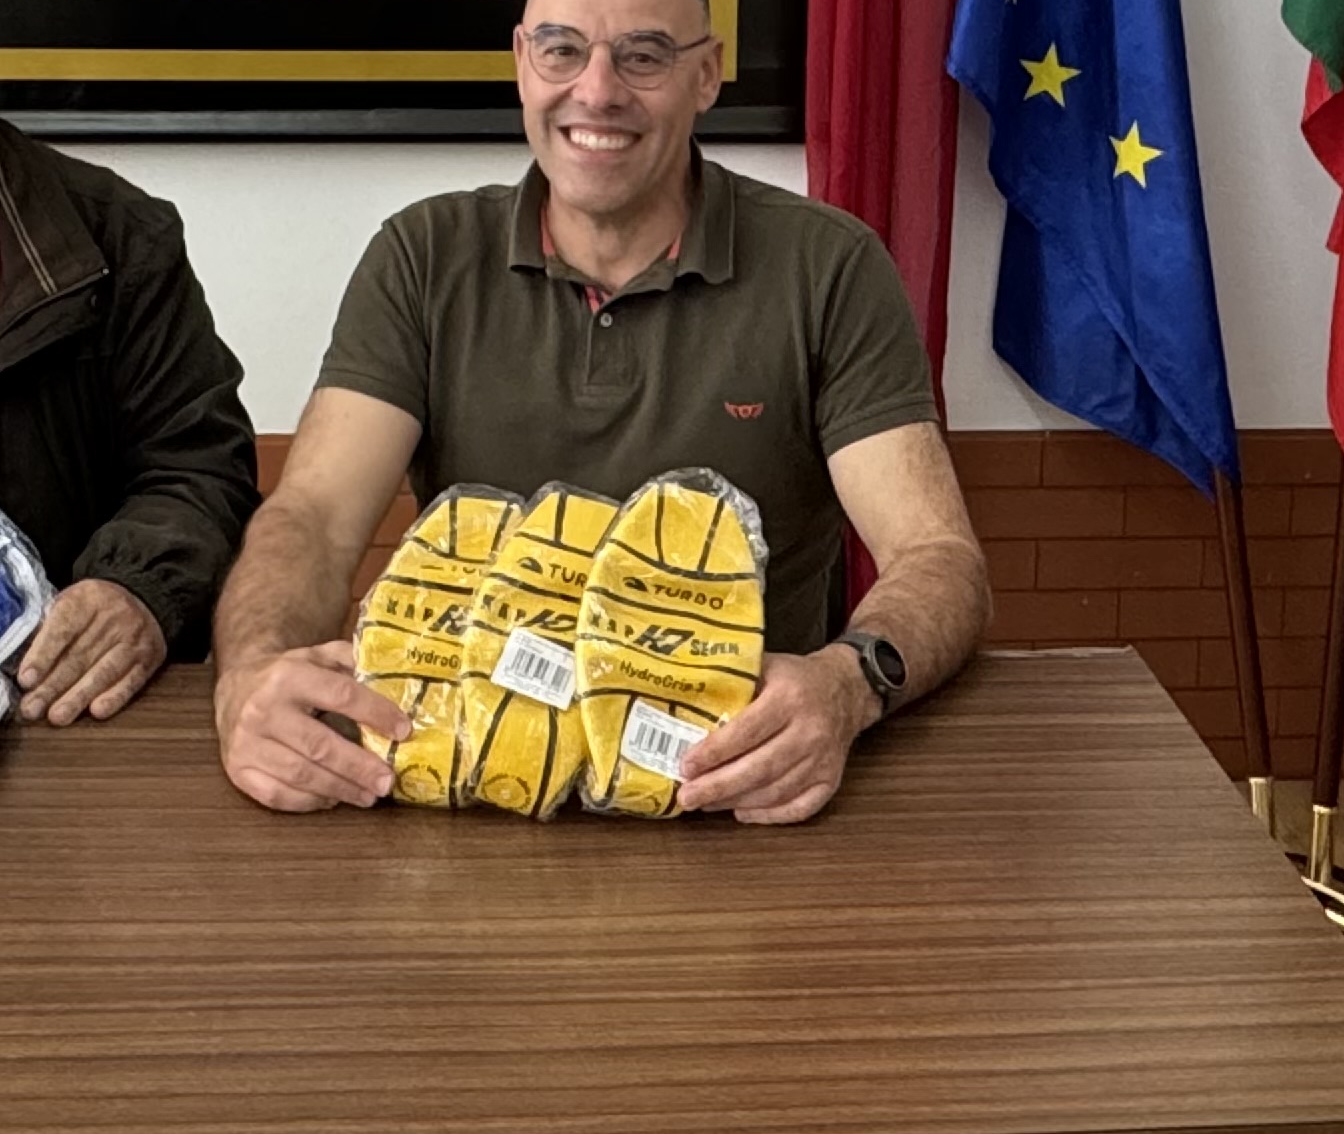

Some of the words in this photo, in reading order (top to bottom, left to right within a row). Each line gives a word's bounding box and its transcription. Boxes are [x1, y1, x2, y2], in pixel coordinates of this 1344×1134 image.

[548, 563, 587, 588] TUR
[652, 583, 725, 611] TURBO
[406, 646, 461, 670] HydroG
